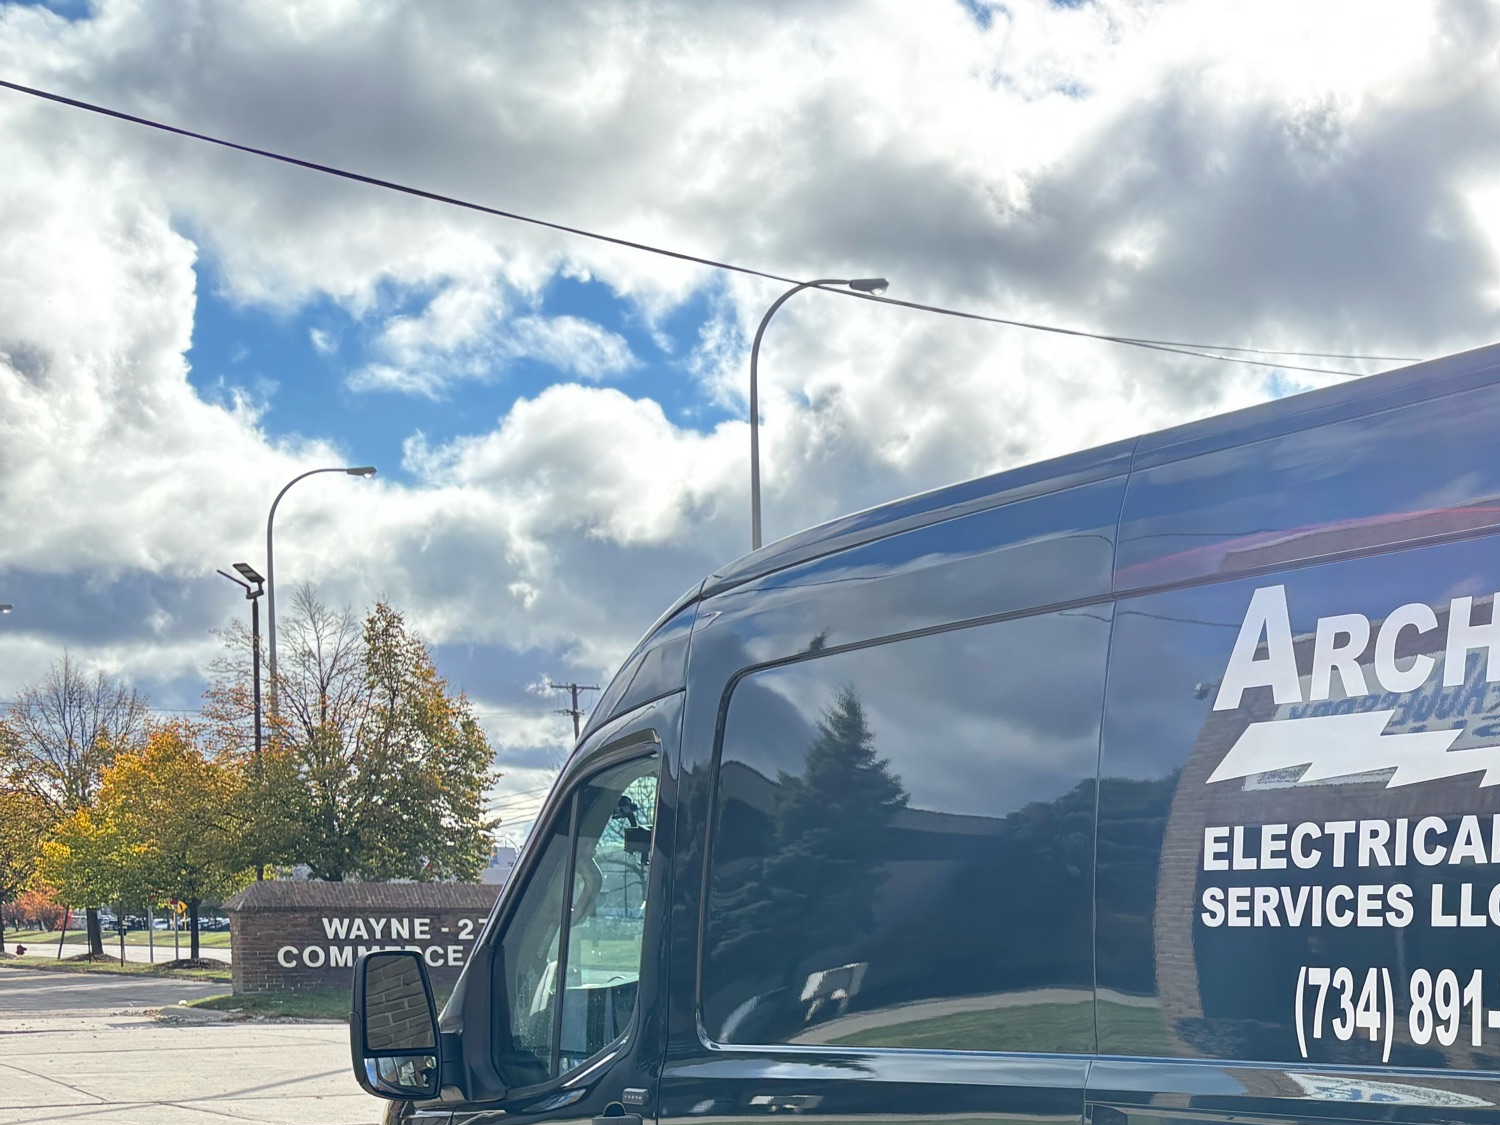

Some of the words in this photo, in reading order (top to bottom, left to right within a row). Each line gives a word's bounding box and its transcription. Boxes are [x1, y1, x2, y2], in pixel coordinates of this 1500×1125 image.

[1201, 883, 1414, 928] SERVICES
[321, 917, 431, 940] WAYNE
[1295, 966, 1394, 1063] (734)
